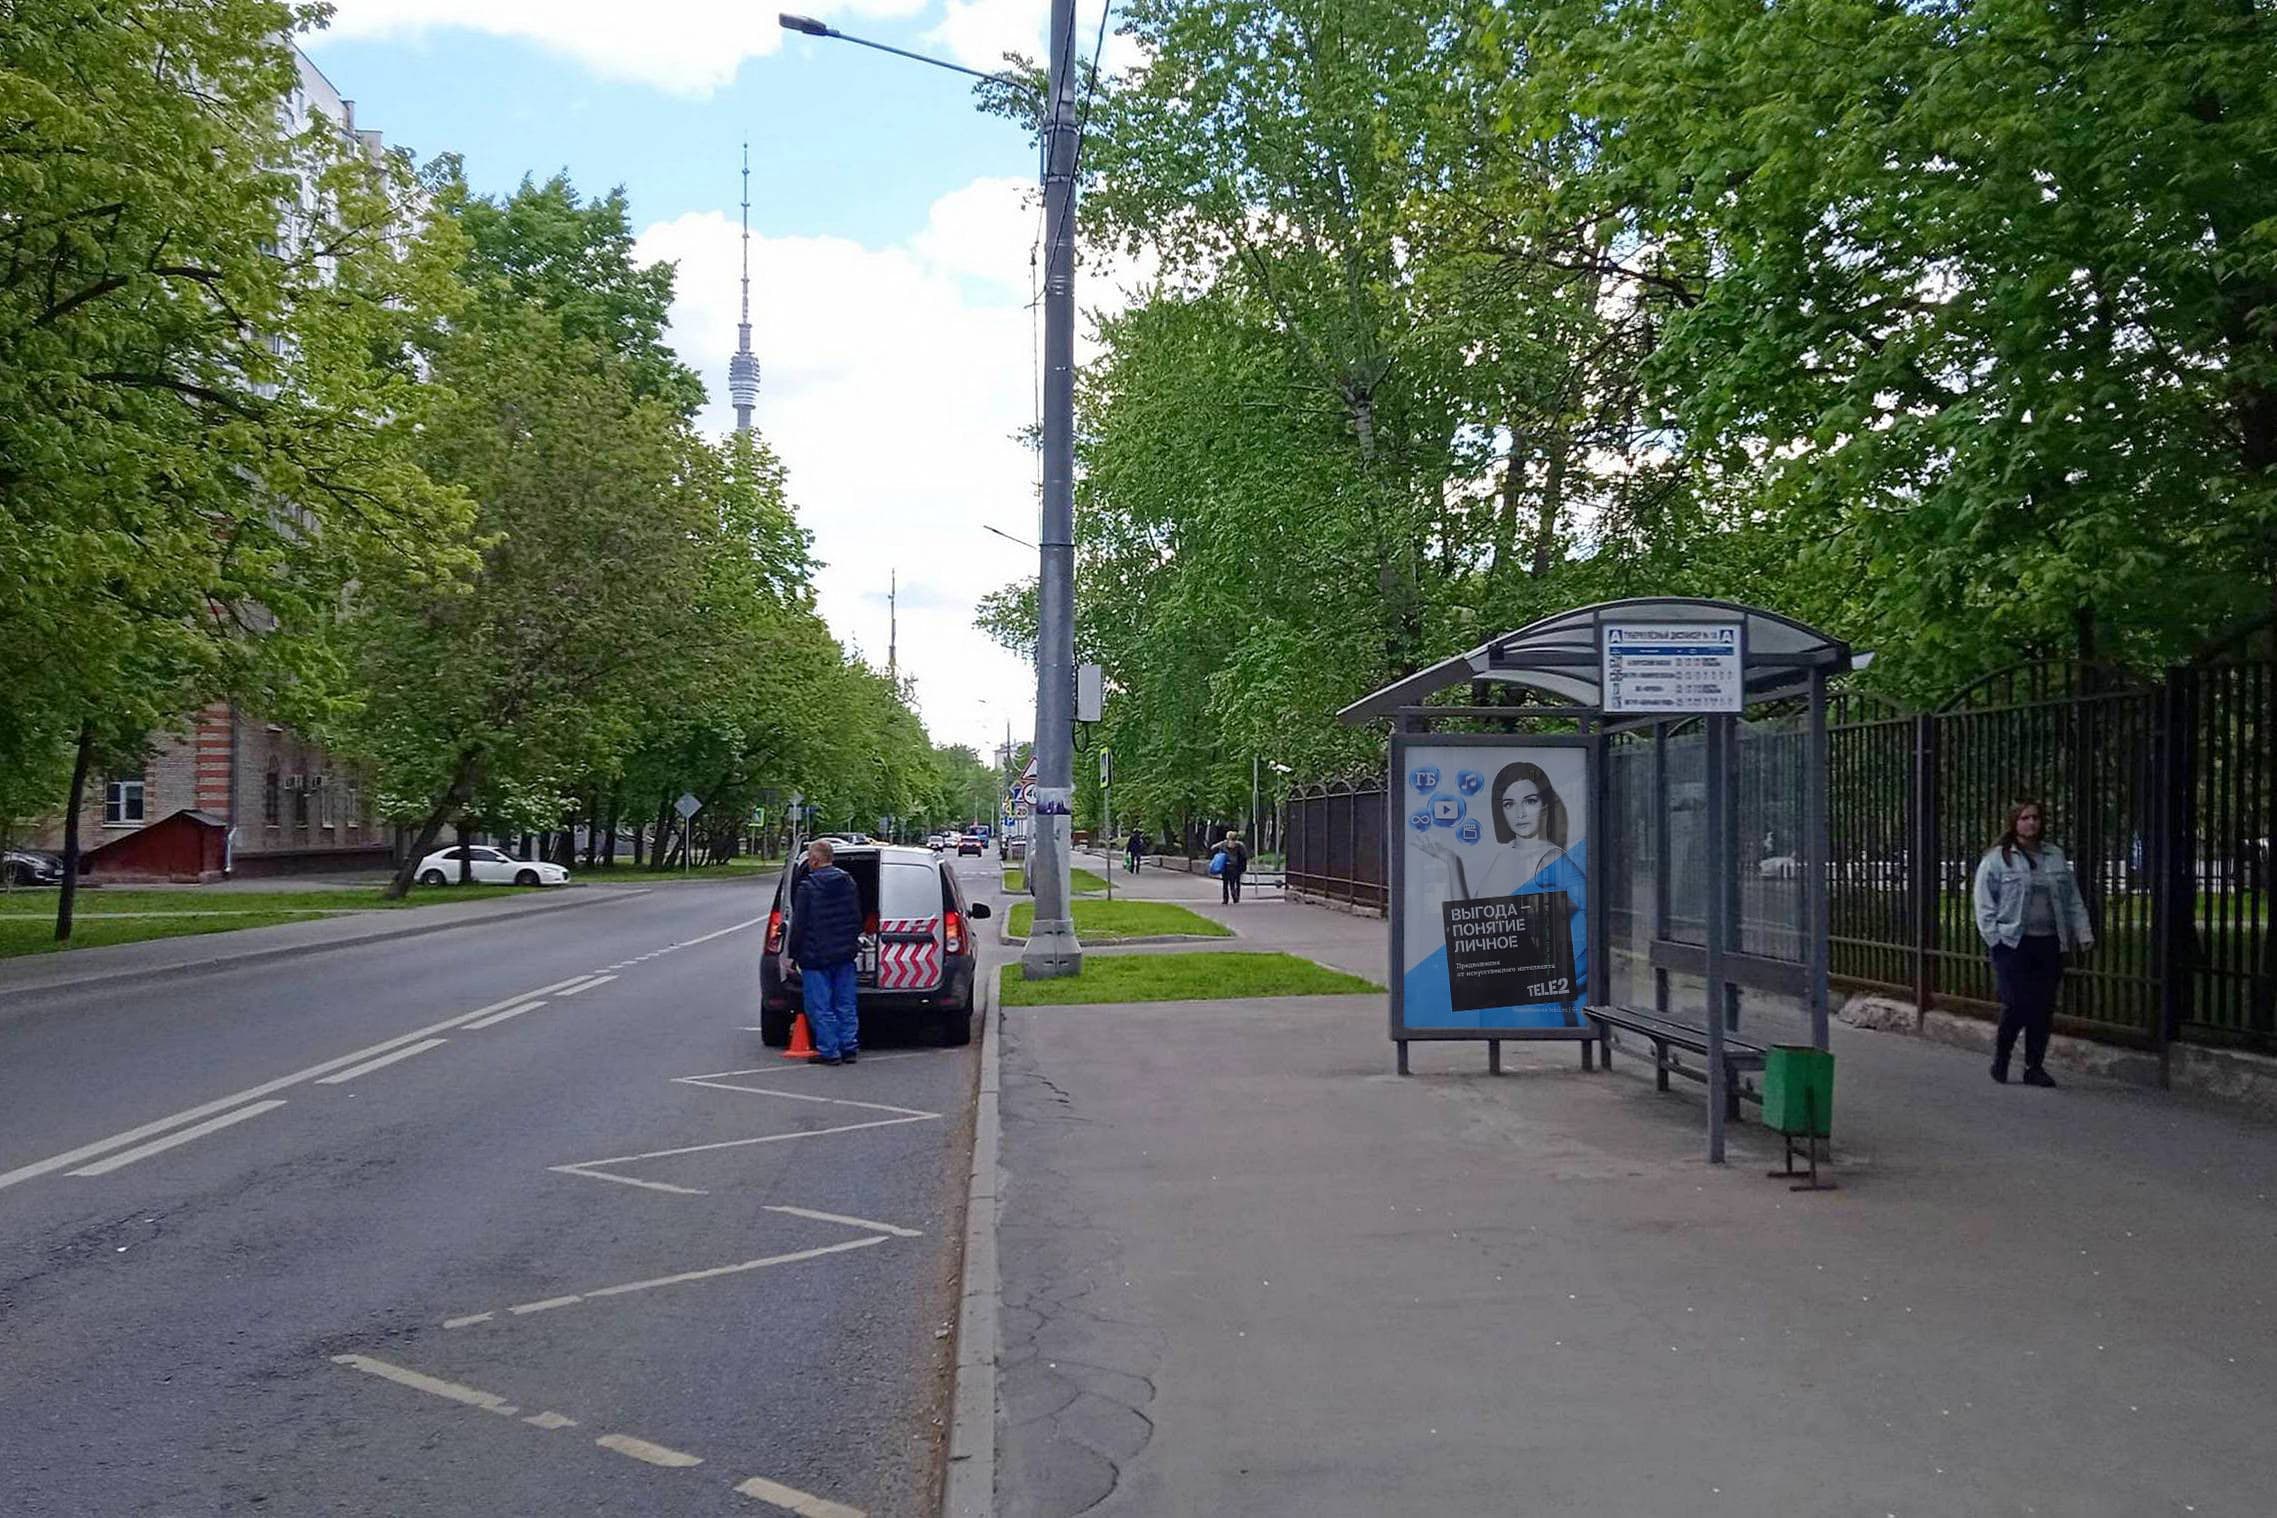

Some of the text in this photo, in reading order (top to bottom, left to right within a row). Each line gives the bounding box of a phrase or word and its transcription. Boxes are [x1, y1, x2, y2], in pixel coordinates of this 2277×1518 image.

[1416, 772, 1436, 786] ГБ
[1451, 904, 1518, 921] ВЫГОДА
[1453, 918, 1526, 937] ПОНЯТИЕ
[1454, 935, 1518, 953] ЛИЧНОЕ
[1527, 977, 1570, 997] TELE2
